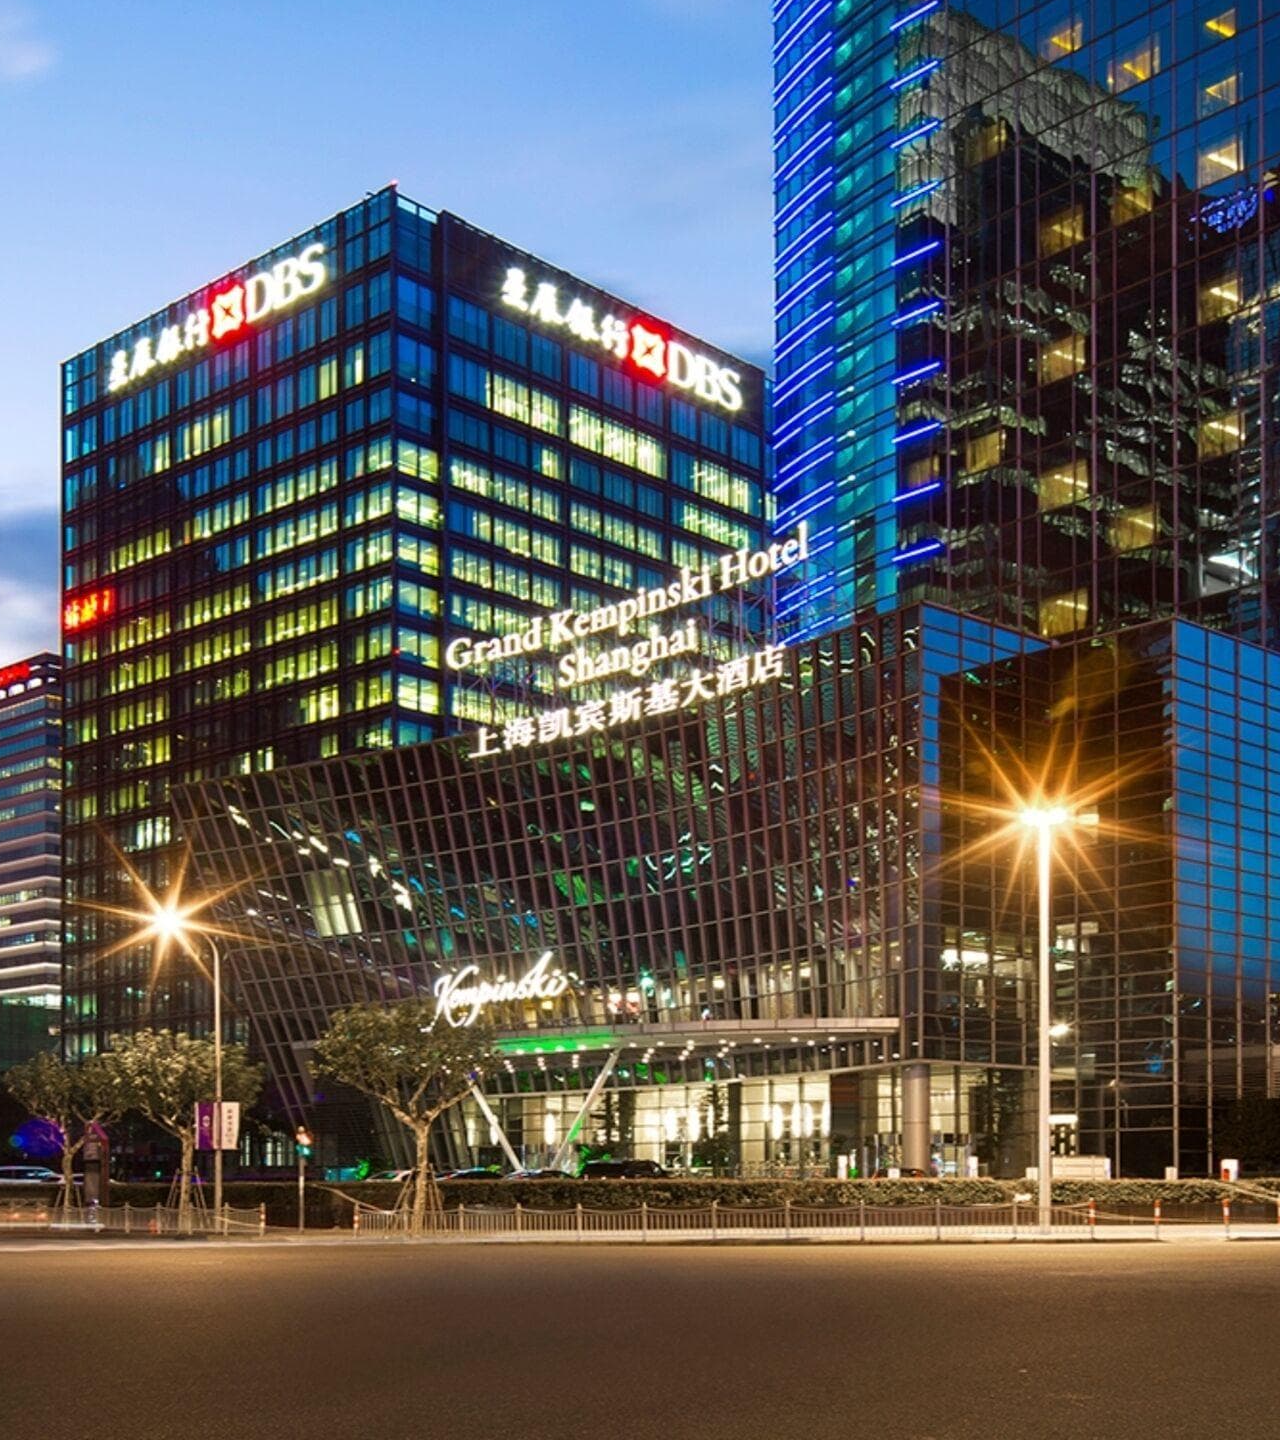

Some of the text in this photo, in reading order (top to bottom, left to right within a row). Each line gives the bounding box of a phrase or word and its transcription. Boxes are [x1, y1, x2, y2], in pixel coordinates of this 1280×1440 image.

[245, 243, 327, 323] DBS
[667, 340, 743, 411] DBS
[445, 520, 810, 671] Grand Kempinski Hotel
[558, 619, 699, 688] Shanghai
[469, 643, 786, 758] 上海凯宾斯基大酒店
[420, 951, 568, 1033] Kempinski
